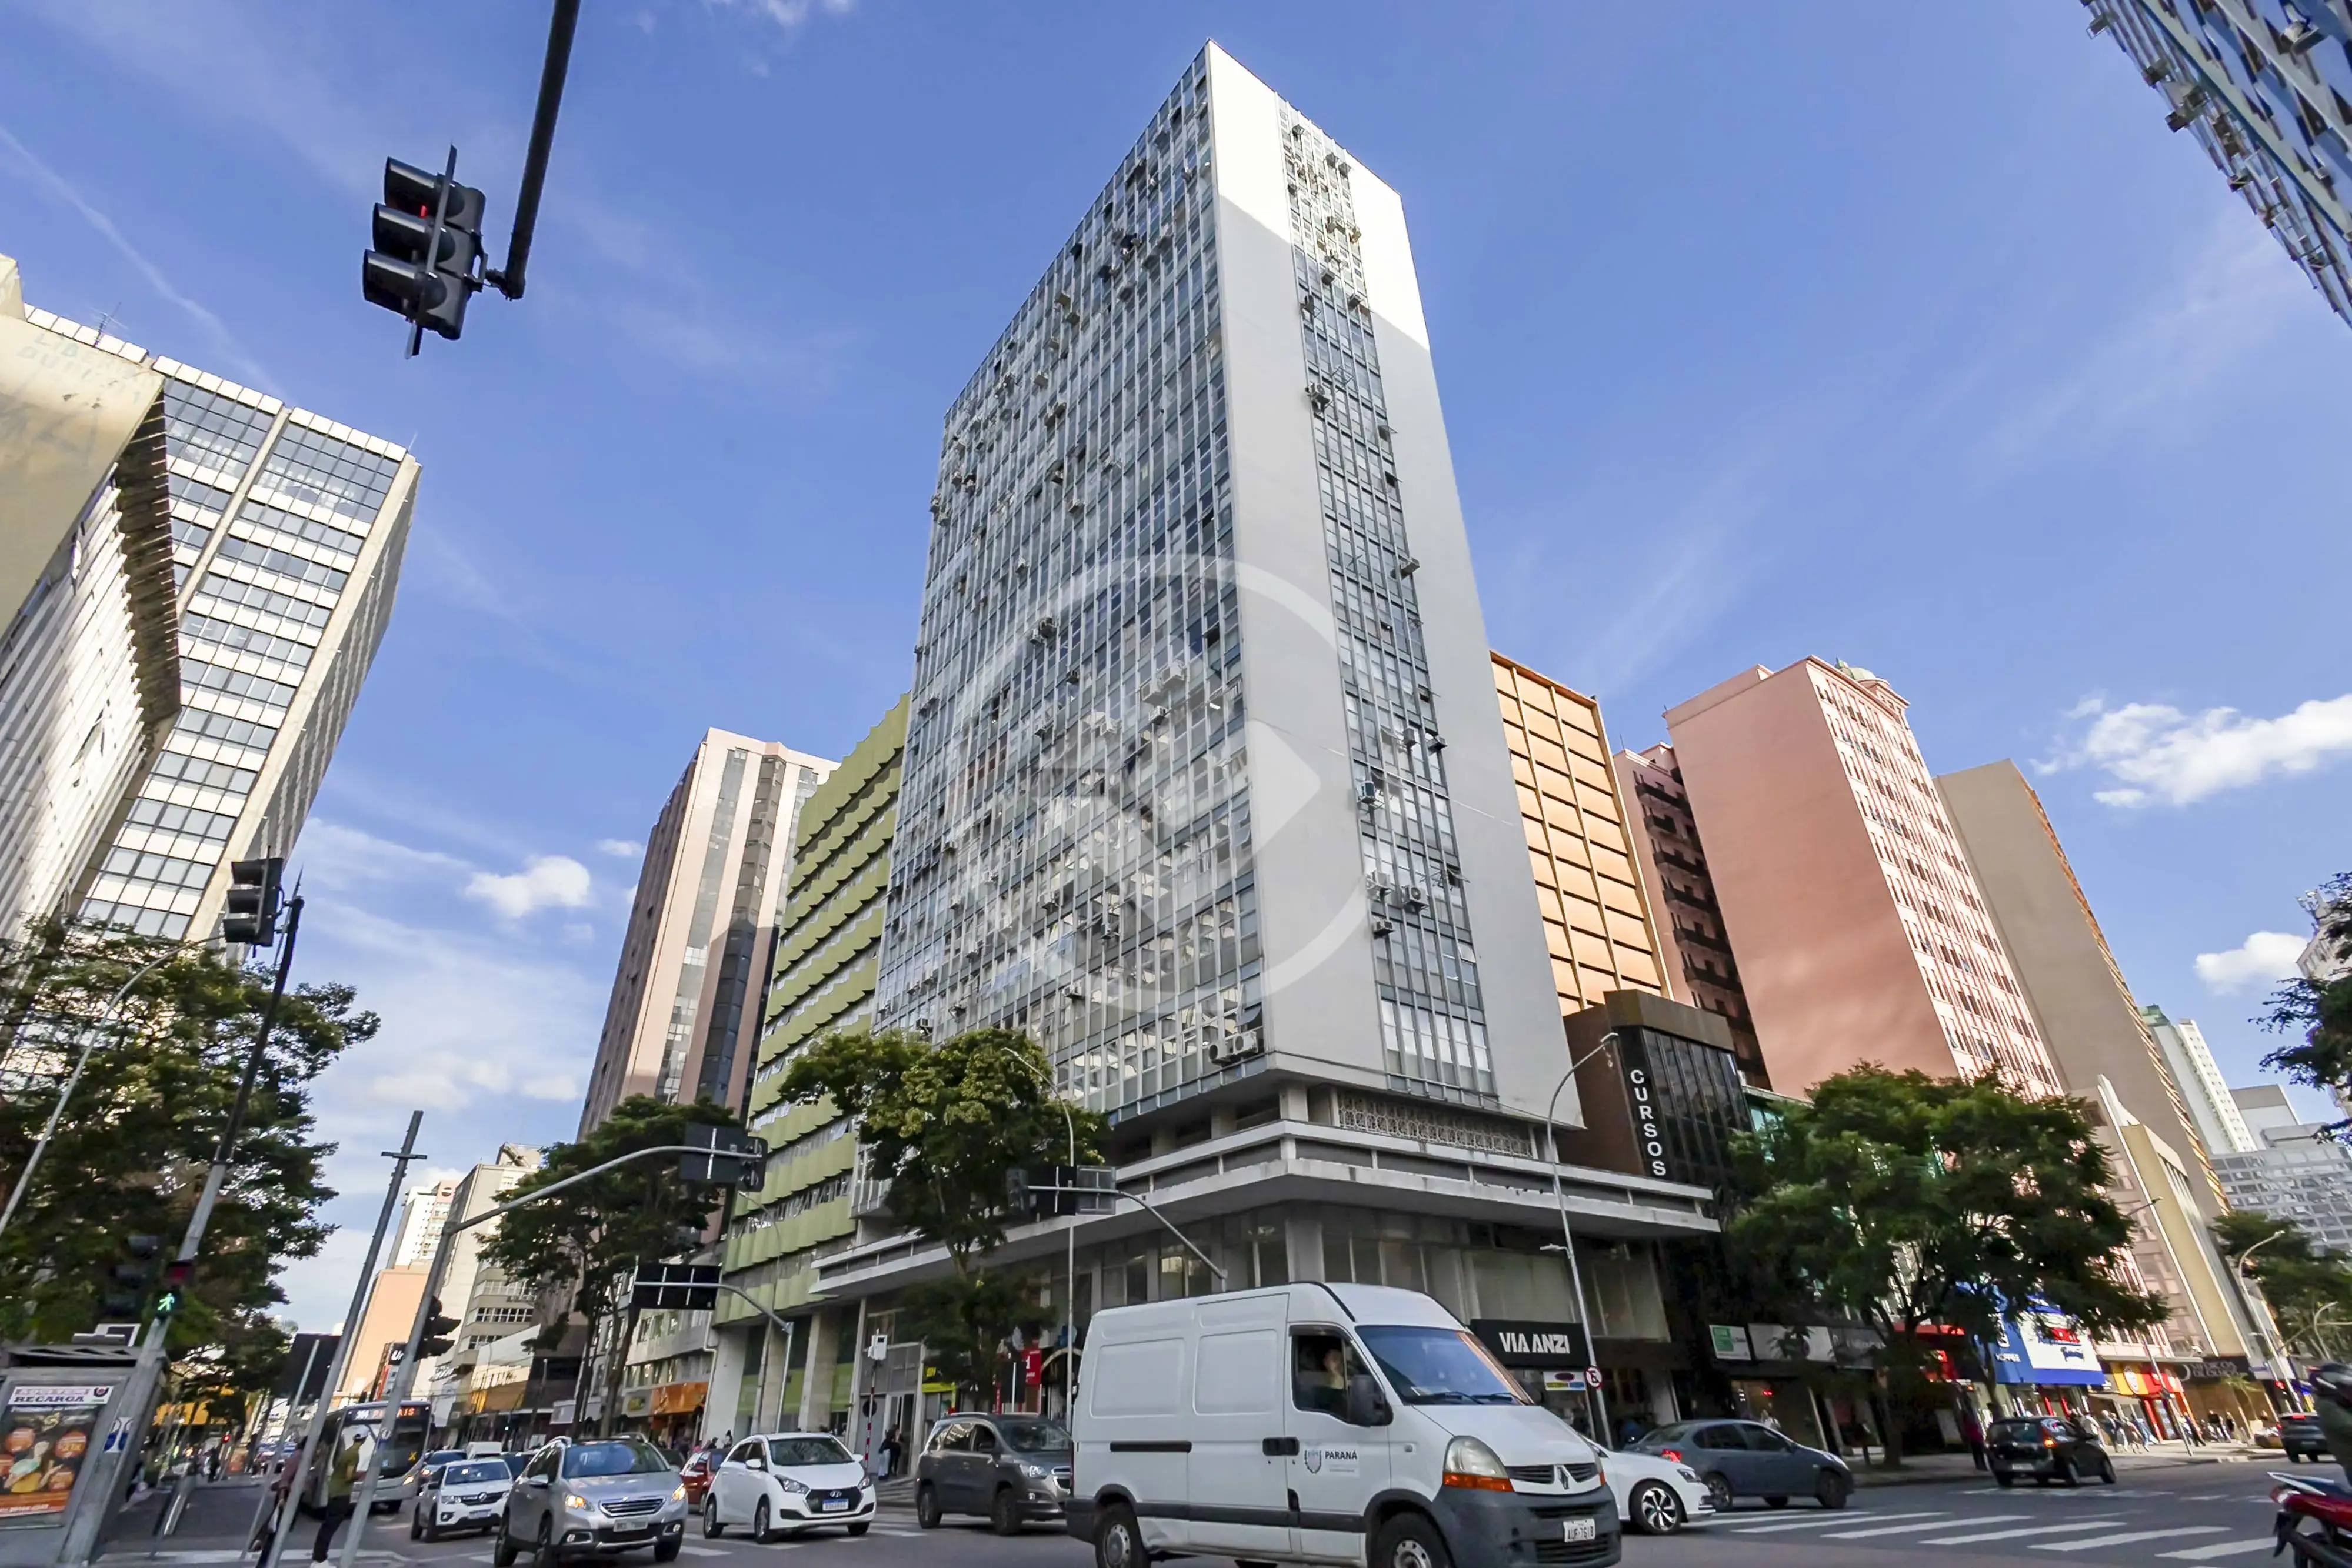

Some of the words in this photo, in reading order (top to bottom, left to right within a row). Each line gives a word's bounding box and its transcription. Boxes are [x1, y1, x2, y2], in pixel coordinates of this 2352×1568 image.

[1630, 1069, 1666, 1176] CURSOS
[1499, 1332, 1530, 1353] VIA
[1532, 1333, 1570, 1354] ANZI
[1325, 1450, 1357, 1459] PARANÁ
